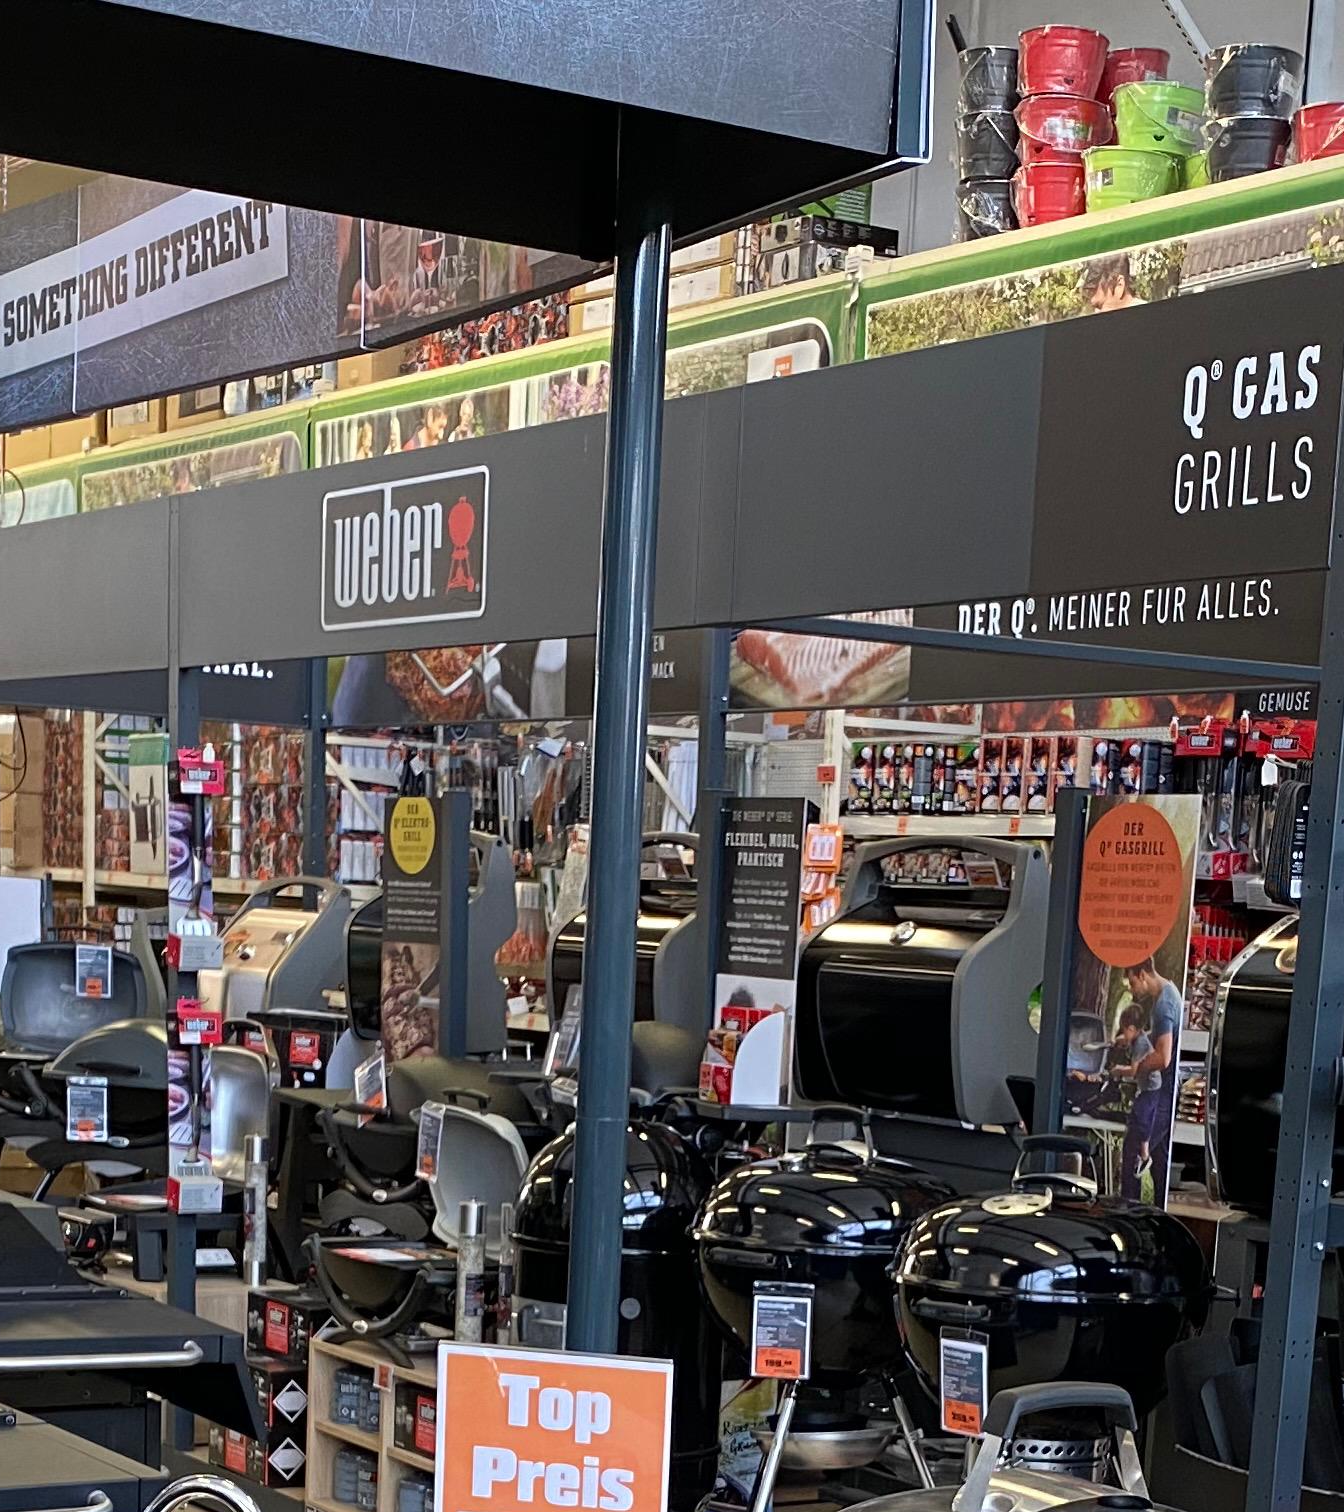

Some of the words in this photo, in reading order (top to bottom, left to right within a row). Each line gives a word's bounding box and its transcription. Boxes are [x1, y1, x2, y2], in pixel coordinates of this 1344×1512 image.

[3, 254, 128, 347] SOMETHING
[135, 201, 273, 298] DIFFERENT
[1233, 344, 1321, 419] GAS
[1174, 436, 1313, 514] GRILLS
[333, 486, 443, 608] weber
[958, 603, 1001, 635] DER
[1049, 592, 1130, 632] MEINER
[1197, 578, 1280, 621] ALLES.
[1115, 841, 1165, 856] GASGRILL
[1123, 822, 1144, 836] DER
[499, 1372, 612, 1444] Top
[471, 1445, 635, 1512] Preis
